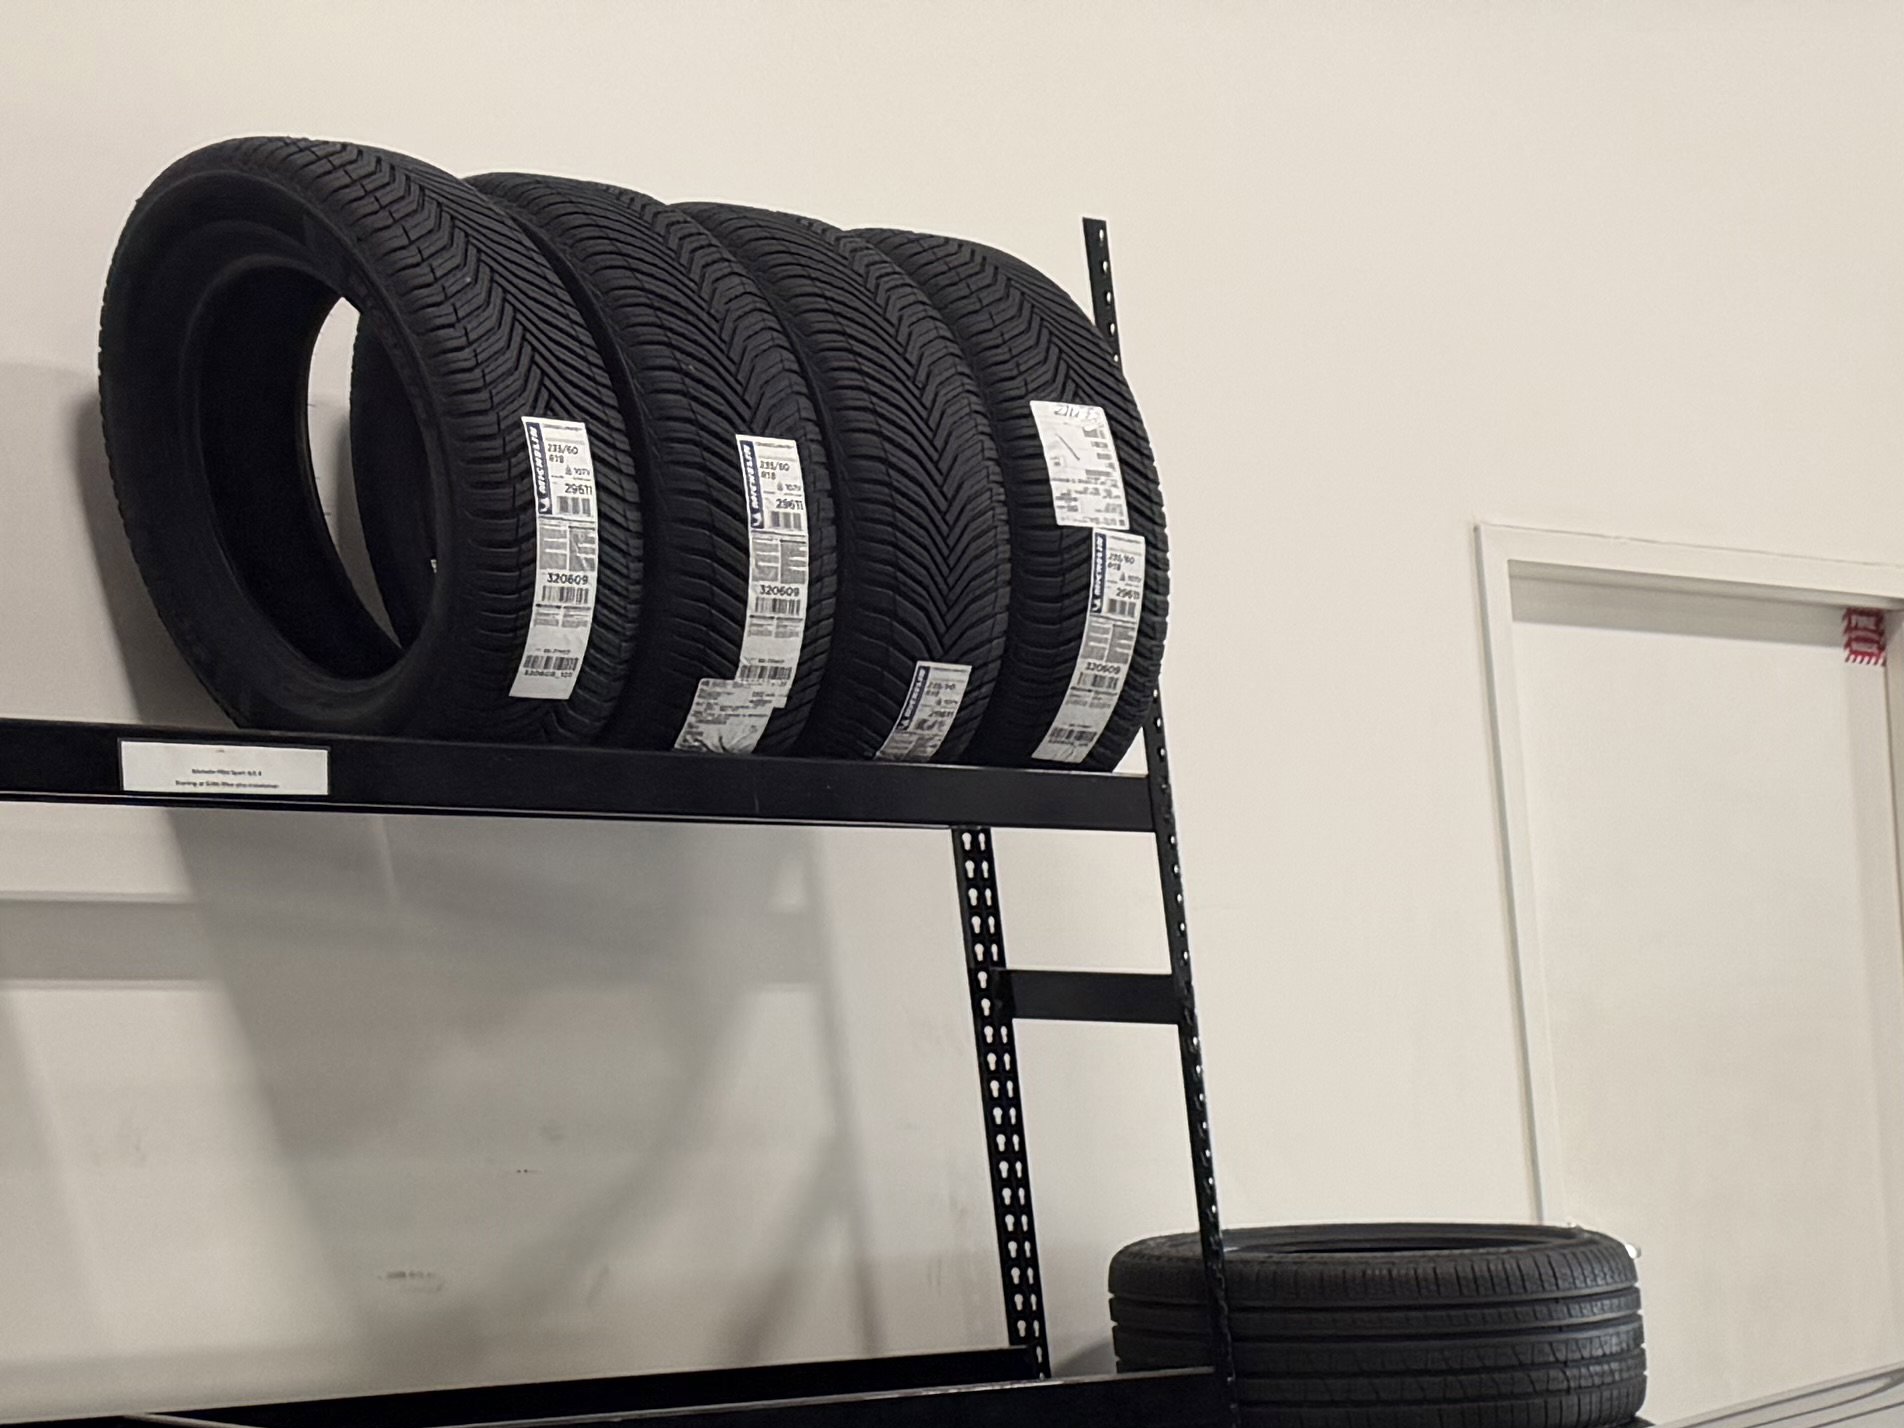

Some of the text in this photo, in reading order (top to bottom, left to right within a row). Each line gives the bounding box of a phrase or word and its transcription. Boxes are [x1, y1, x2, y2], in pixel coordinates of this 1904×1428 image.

[528, 425, 548, 495] MICHELIN
[564, 482, 593, 496] 29611
[546, 572, 589, 585] 320609
[758, 584, 800, 597] 320609
